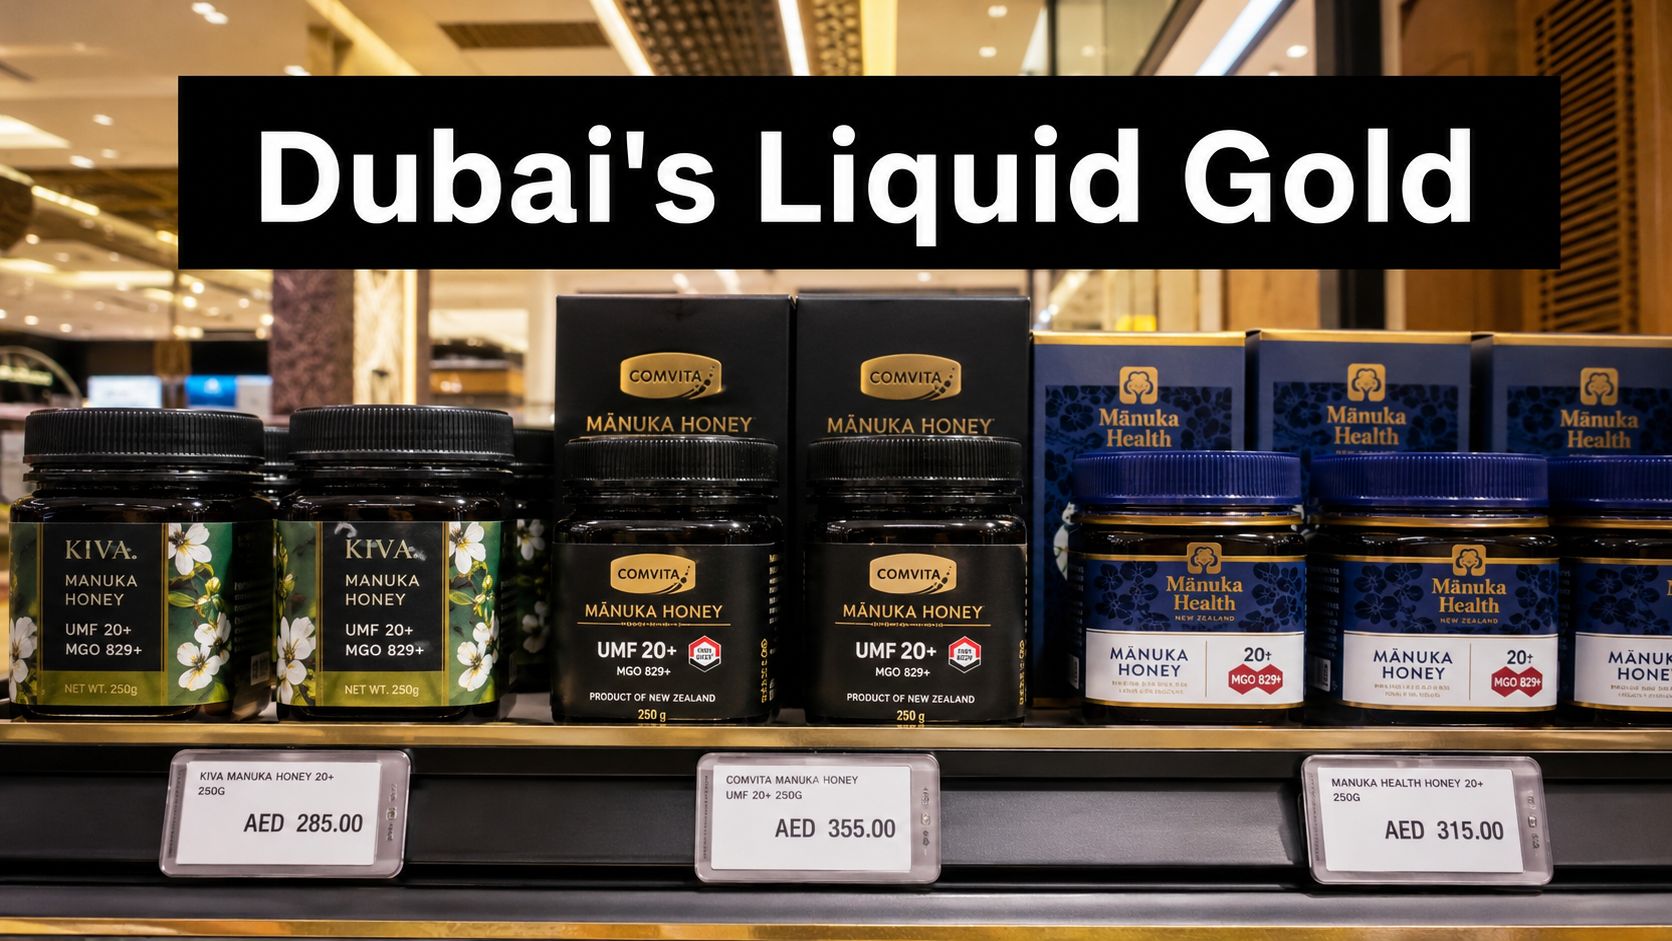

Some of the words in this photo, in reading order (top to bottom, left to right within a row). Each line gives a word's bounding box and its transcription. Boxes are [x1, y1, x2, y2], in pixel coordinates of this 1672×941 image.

[628, 368, 703, 383] COMVITA
[869, 370, 943, 385] COMVITA
[681, 416, 753, 433] HONEY
[921, 417, 992, 435] HONEY
[1105, 428, 1173, 449] Health
[1332, 426, 1401, 447] Health
[1566, 429, 1633, 449] Health
[65, 574, 138, 588] MANUKA
[345, 574, 420, 587] MANUKA
[617, 568, 680, 580] COMVITA
[876, 568, 941, 581] COMVITA
[65, 592, 125, 607] HONEY
[345, 592, 406, 606] HONEY
[1173, 594, 1236, 611] Health
[1439, 596, 1500, 614] Health
[663, 604, 723, 619] HONEY
[922, 604, 983, 619] HONEY
[1174, 614, 1194, 622] NEW
[1196, 613, 1235, 622] ZEALAND
[65, 623, 98, 636] UMF
[103, 623, 132, 637] 20+
[345, 623, 380, 637] UMF
[385, 623, 414, 637] 20+
[65, 642, 101, 656] MGO
[105, 643, 143, 656] 829+
[345, 643, 382, 657] MGO
[387, 643, 425, 657] 829+
[597, 641, 638, 659] UMF
[641, 641, 677, 659] 20+
[855, 641, 897, 659] UMF
[900, 641, 937, 660] 20+
[616, 665, 642, 677] MGO
[644, 666, 671, 677] 829+
[875, 666, 901, 678] MGO
[903, 667, 931, 678] 829+
[1118, 663, 1181, 678] HONEY
[1382, 665, 1446, 680] HONEY
[1617, 668, 1672, 681] HONE
[1231, 674, 1256, 685] MGO
[1258, 674, 1282, 685] 829+
[1494, 676, 1518, 688] MGO
[1519, 676, 1542, 688] 829+
[64, 683, 86, 694] NET
[87, 683, 107, 694] WT.
[110, 682, 138, 697] 250g
[344, 684, 367, 695] NET
[368, 684, 390, 695] WT.
[391, 684, 420, 698] 250g
[589, 691, 632, 702] PRODUCT
[633, 692, 647, 702] OF
[648, 693, 671, 702] NEW
[672, 693, 716, 703] ZEALAND
[846, 692, 891, 703] PRODUCT
[892, 693, 906, 703] OF
[907, 694, 930, 704] NEW
[931, 694, 976, 704] ZEALAND
[637, 708, 658, 720] 250
[659, 711, 667, 723] g
[896, 709, 916, 721] 250
[917, 712, 926, 724] g
[199, 771, 224, 781] KIVA
[226, 771, 273, 781] MANUKA
[275, 771, 312, 782] HONEY
[314, 771, 335, 782] 20+
[725, 775, 772, 785] COMVITA
[775, 775, 820, 785] MANUKA
[823, 775, 859, 785] HONEY
[1331, 778, 1378, 788] MANUKA
[1380, 778, 1422, 788] HEALTH
[1424, 778, 1461, 788] HONEY
[1464, 778, 1484, 789] 20+
[197, 786, 226, 796] 250G
[725, 790, 749, 800] UMF
[752, 790, 772, 800] 20+
[775, 790, 803, 800] 250G
[1333, 792, 1361, 802] 250G
[243, 813, 285, 833] AED
[296, 813, 363, 833] 285.00
[774, 818, 816, 838] AED
[828, 818, 896, 839] 355.00
[1385, 820, 1425, 840] AED
[1436, 820, 1504, 841] 315.00
